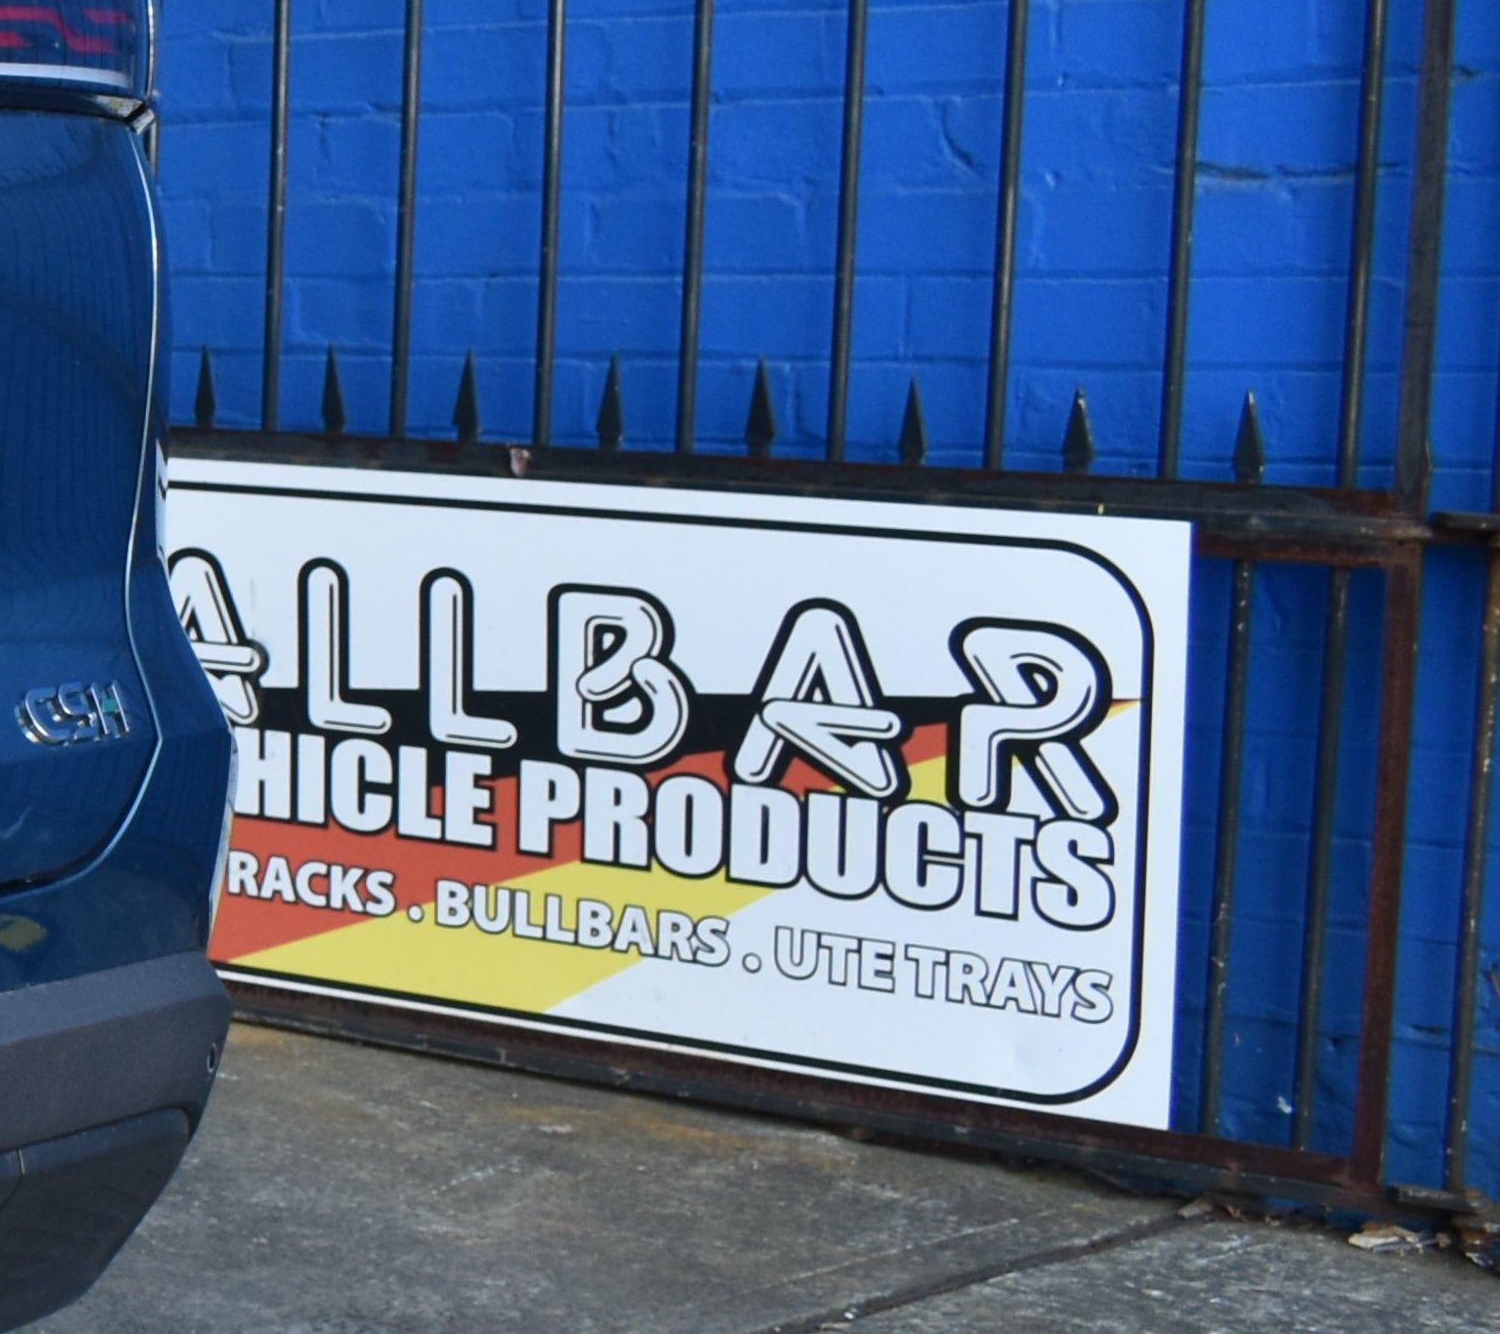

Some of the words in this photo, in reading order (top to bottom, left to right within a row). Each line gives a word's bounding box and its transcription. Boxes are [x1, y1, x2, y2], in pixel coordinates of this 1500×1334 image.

[165, 547, 1119, 824] ALLBAR
[516, 758, 1117, 933] PRODUCTS
[226, 849, 397, 919] RACKS
[434, 878, 733, 968] BULLBARS
[774, 925, 896, 994] UTE
[904, 943, 1114, 1024] TRAYS
